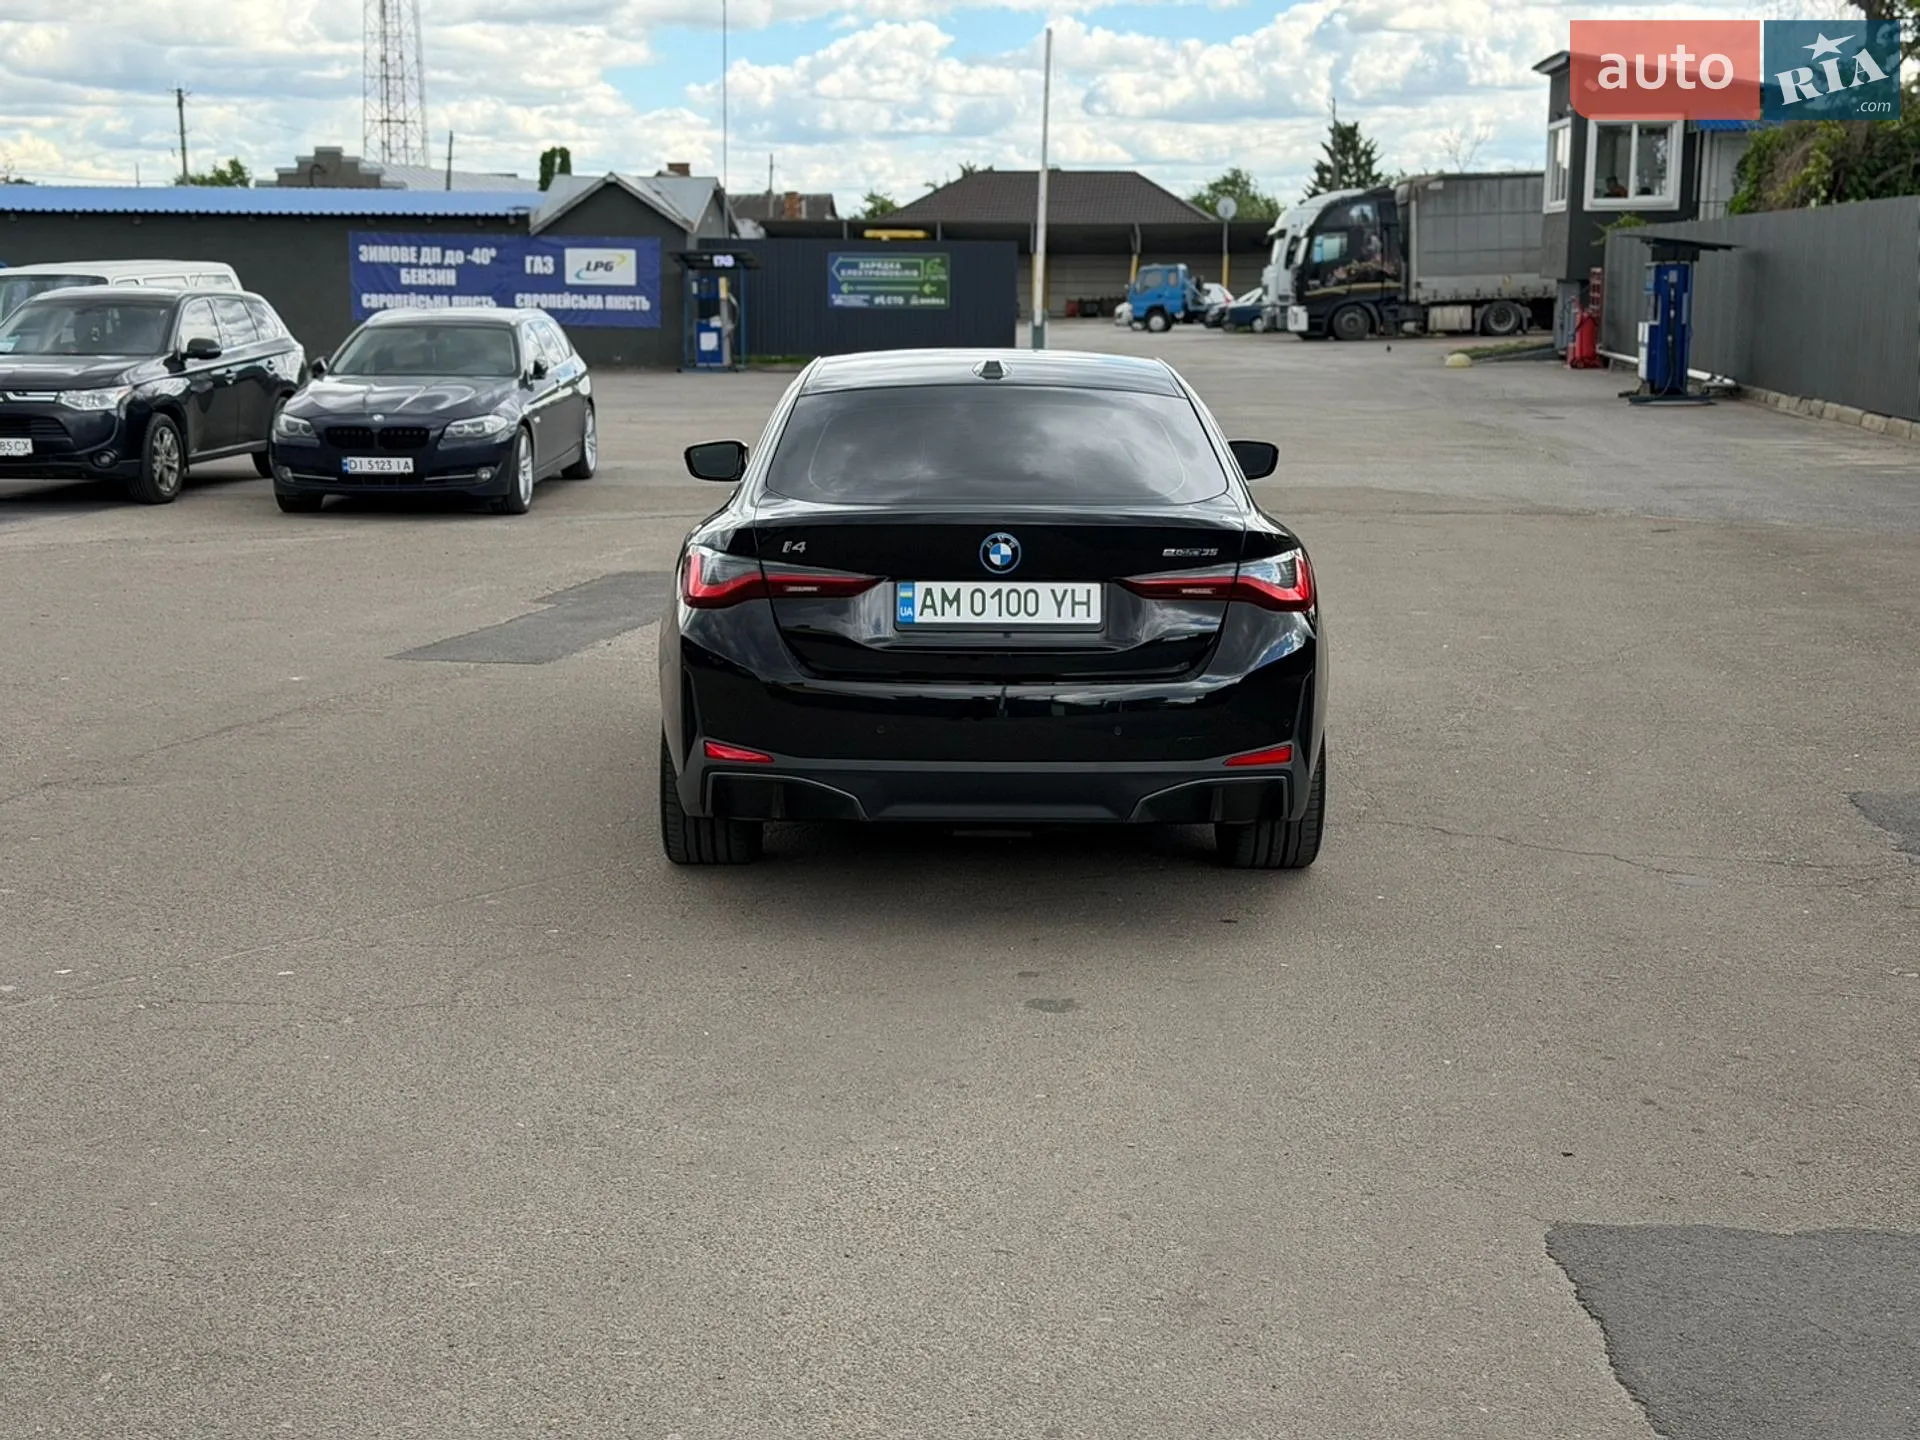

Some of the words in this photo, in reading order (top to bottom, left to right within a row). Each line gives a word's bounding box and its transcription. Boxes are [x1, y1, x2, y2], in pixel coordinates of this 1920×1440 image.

[358, 245, 418, 262] ЗИМОВЕ
[420, 246, 442, 266] ДП
[524, 255, 554, 275] ГАЗ
[585, 260, 616, 272] LPG
[400, 268, 457, 286] БЕНЗИН
[367, 460, 393, 471] 5123
[919, 588, 961, 617] AM
[970, 588, 1039, 617] 0100
[1050, 588, 1091, 618] YH
[899, 608, 913, 617] UA
